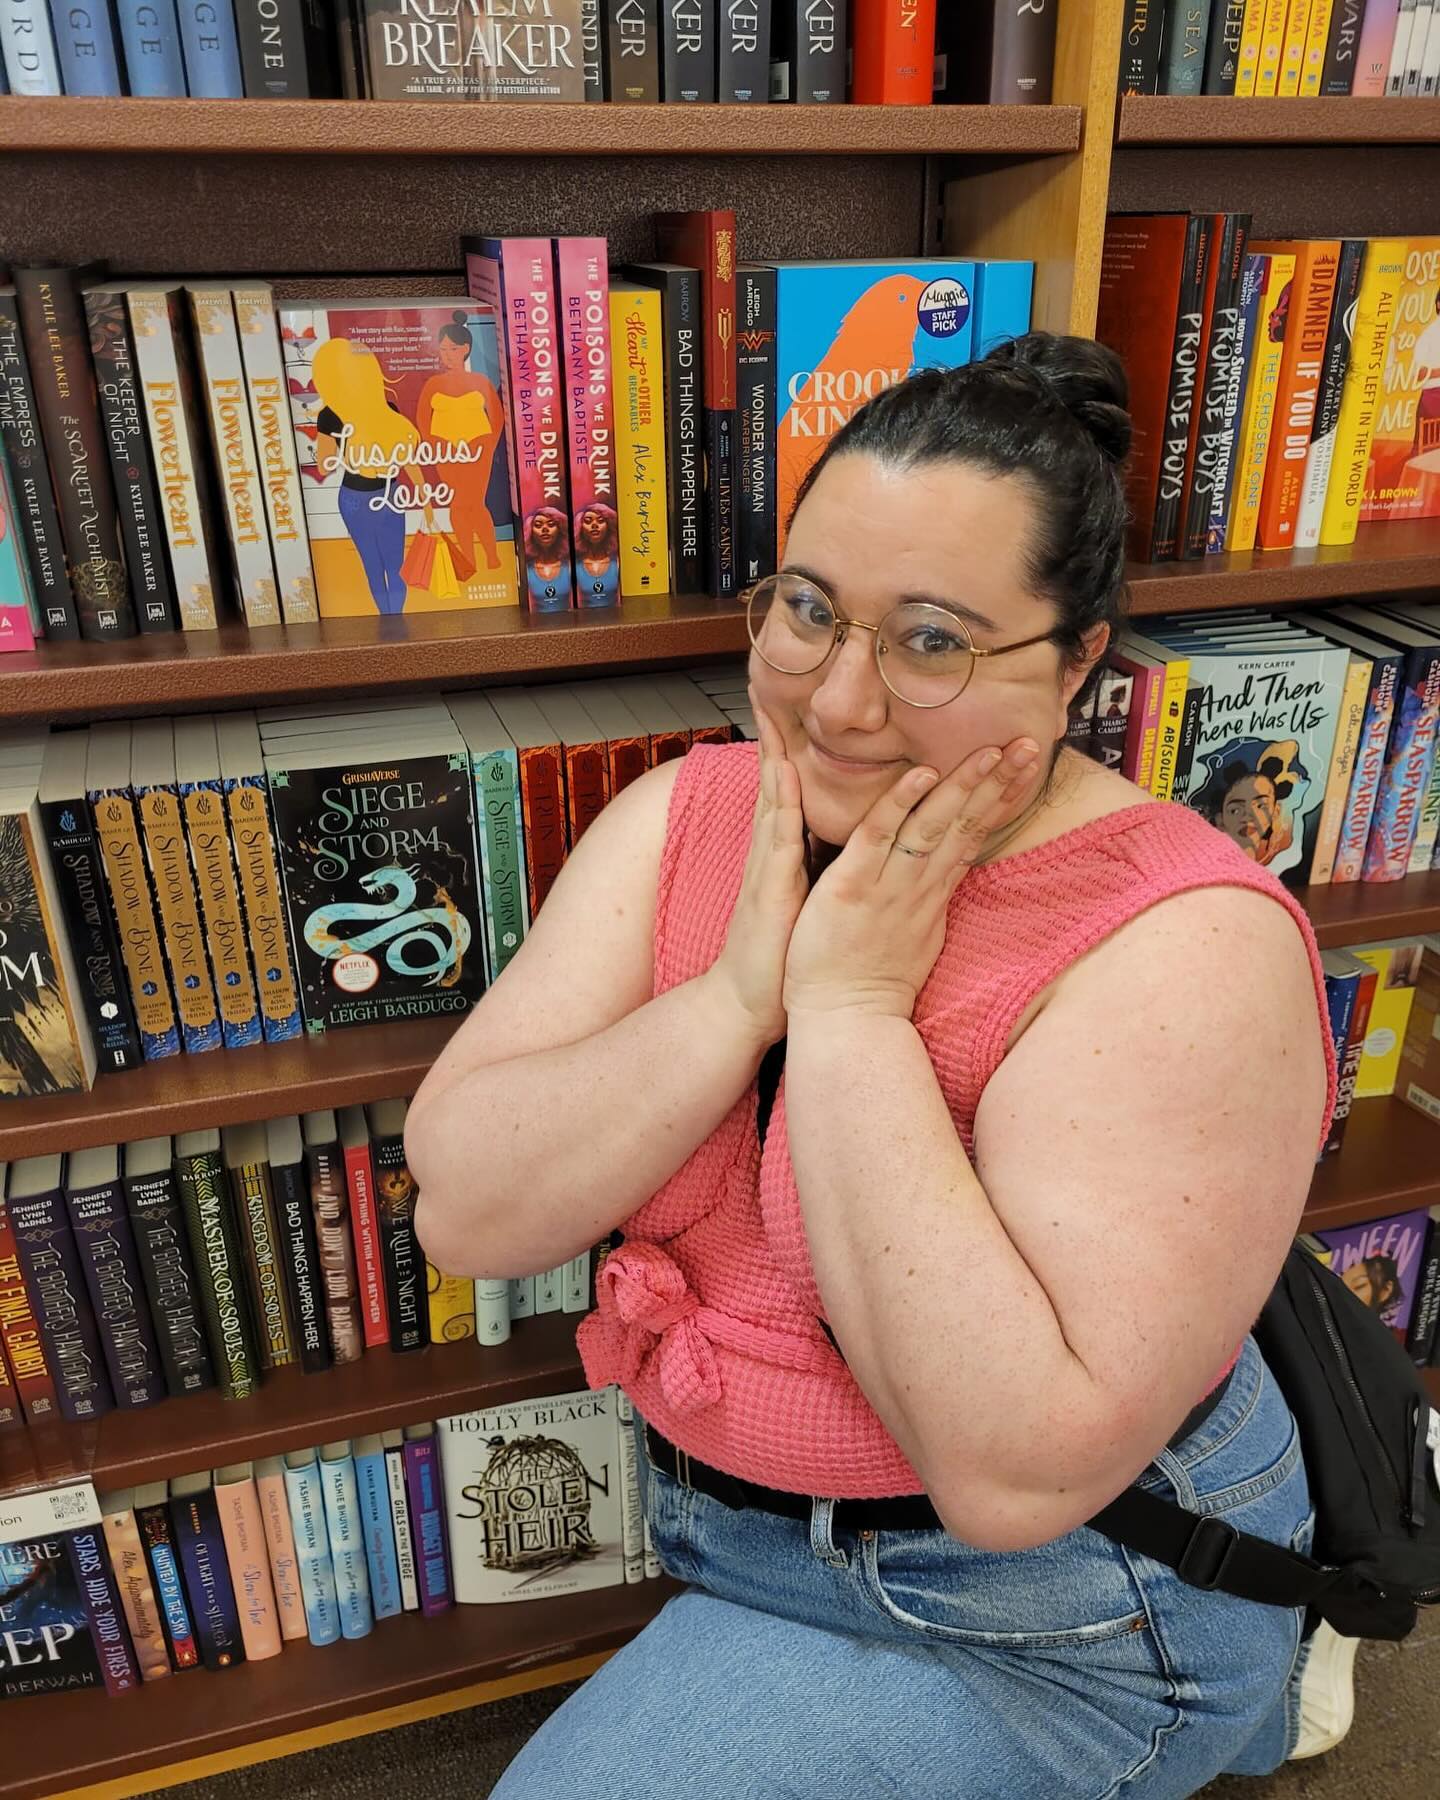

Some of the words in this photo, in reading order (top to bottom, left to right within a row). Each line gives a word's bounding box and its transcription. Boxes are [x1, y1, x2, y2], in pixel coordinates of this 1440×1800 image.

[382, 22, 576, 74] BREAKER
[1184, 10, 1201, 58] SEA
[423, 76, 444, 85] TRUE
[583, 62, 599, 85] IT
[530, 258, 542, 282] THE
[585, 256, 598, 281] THE
[746, 278, 754, 327] BARDUGO
[923, 287, 967, 310] Maggie
[932, 310, 956, 321] STAFF
[1378, 291, 1391, 316] ALL
[513, 298, 529, 382] BETHANY
[529, 291, 555, 398] POISONS
[569, 297, 583, 380] BETHANY
[585, 289, 607, 395] POISONS
[932, 319, 957, 332] PICK
[1368, 322, 1388, 370] THAT'S
[111, 338, 129, 371] THE
[678, 329, 693, 369] BAD
[1170, 312, 1203, 429] PROMISE
[1205, 308, 1240, 423] PROMISE
[1265, 354, 1280, 383] THE
[1296, 361, 1319, 377] IF
[1330, 343, 1342, 373] WISH
[103, 383, 117, 406] OF
[119, 377, 140, 436] KEEPER
[679, 373, 695, 441] THINGS
[1288, 383, 1316, 428] YOU
[1363, 372, 1378, 407] LEFT
[9, 377, 36, 448] EMPRESS
[59, 415, 80, 426] The
[520, 389, 537, 468] BAPTISTE
[575, 386, 588, 465] BAPTISTE
[752, 384, 764, 449] WONDER
[1255, 393, 1273, 464] CHOSEN
[1376, 401, 1415, 433] ME
[108, 410, 130, 463] NIGHT
[322, 423, 482, 471] Luscious
[741, 409, 751, 494] WARBRINGER
[1283, 432, 1311, 461] DO
[1352, 429, 1368, 457] THE
[145, 381, 197, 549] Flowerheart
[212, 377, 262, 545] Flowerheart
[251, 377, 299, 543] Flowerheart
[537, 431, 561, 499] DRINK
[588, 429, 611, 496] DRINK
[681, 444, 696, 511] HAPPEN
[1161, 437, 1188, 500] BOYS
[1195, 433, 1222, 495] BOYS
[1210, 427, 1234, 517] WITCHCRAFT
[368, 464, 455, 513] Love
[719, 478, 731, 518] LIVES
[752, 451, 764, 513] WOMAN
[1345, 459, 1364, 507] WORLD
[1380, 487, 1419, 499] BROWN
[682, 512, 697, 557] HERE
[719, 526, 732, 571] SAINTS
[38, 547, 53, 587] BAKER
[141, 547, 157, 592] BAKER
[1263, 661, 1295, 669] CARTER
[1201, 675, 1257, 723] And
[1257, 671, 1325, 706] Then
[1250, 708, 1288, 733] Was
[1290, 701, 1329, 734] Us
[1097, 725, 1126, 735] CAMERON
[1101, 718, 1127, 727] SHARON
[1184, 701, 1198, 747] CARSON
[342, 769, 401, 785] GRISHAVERSE
[1173, 775, 1190, 789] ANY
[1346, 721, 1386, 851] SEASPARROW
[1388, 715, 1434, 862] SEASPARROW
[318, 782, 427, 833] SIEGE
[360, 816, 390, 830] AND
[487, 800, 512, 850] SIEGE
[198, 833, 227, 902] SHADOW
[240, 829, 270, 898] SHADOW
[108, 841, 141, 911] SHADOW
[126, 925, 154, 975] BONE
[151, 835, 184, 904] SHADOW
[171, 921, 197, 968] BONE
[493, 868, 517, 927] STORM
[212, 916, 238, 966] BONE
[254, 911, 279, 962] BONE
[339, 960, 370, 971] NETFLIX
[329, 1000, 380, 1024] LEIGH
[385, 996, 467, 1017] BARDUGO
[130, 1179, 170, 1192] JENNIFER
[140, 1189, 163, 1199] LYNN
[182, 1168, 222, 1182] BARRON
[11, 1200, 52, 1215] JENNIFER
[22, 1210, 45, 1220] LYNN
[72, 1190, 112, 1205] JENNIFER
[78, 1206, 113, 1219] BARNES
[82, 1201, 105, 1210] LYNN
[137, 1194, 170, 1207] BARNES
[286, 1201, 301, 1229] BAD
[317, 1194, 341, 1220] AND
[18, 1215, 52, 1229] BARNES
[247, 1194, 273, 1267] KINGDOM
[290, 1228, 308, 1274] THINGS
[322, 1226, 344, 1263] DON'T
[198, 1197, 229, 1278] MASTER
[219, 1307, 245, 1362] SOULS
[297, 1274, 314, 1320] HAPPEN
[326, 1269, 349, 1300] LOOK
[398, 1279, 417, 1324] NIGHT
[6, 1330, 49, 1380] GAMBIT
[303, 1319, 320, 1351] HERE
[449, 1414, 522, 1433] HOLLY
[535, 1400, 607, 1426] BLACK
[299, 1480, 311, 1508] TASHIE
[333, 1472, 345, 1501] TASHIE
[456, 1464, 609, 1519] STOLEN
[303, 1510, 315, 1548] BHUIYAN
[338, 1502, 350, 1541] BHUIYAN
[394, 1500, 406, 1526] GIRLS
[400, 1552, 413, 1580] VERGE
[480, 1514, 596, 1559] HEIR
[73, 1534, 102, 1576] STARS,
[154, 1548, 174, 1585] HUNTED
[311, 1558, 320, 1576] STAY
[85, 1577, 108, 1607] HIDE
[94, 1609, 120, 1642] YOUR
[103, 1644, 131, 1678] FIRES
[5, 1672, 94, 1694] BERWAH
